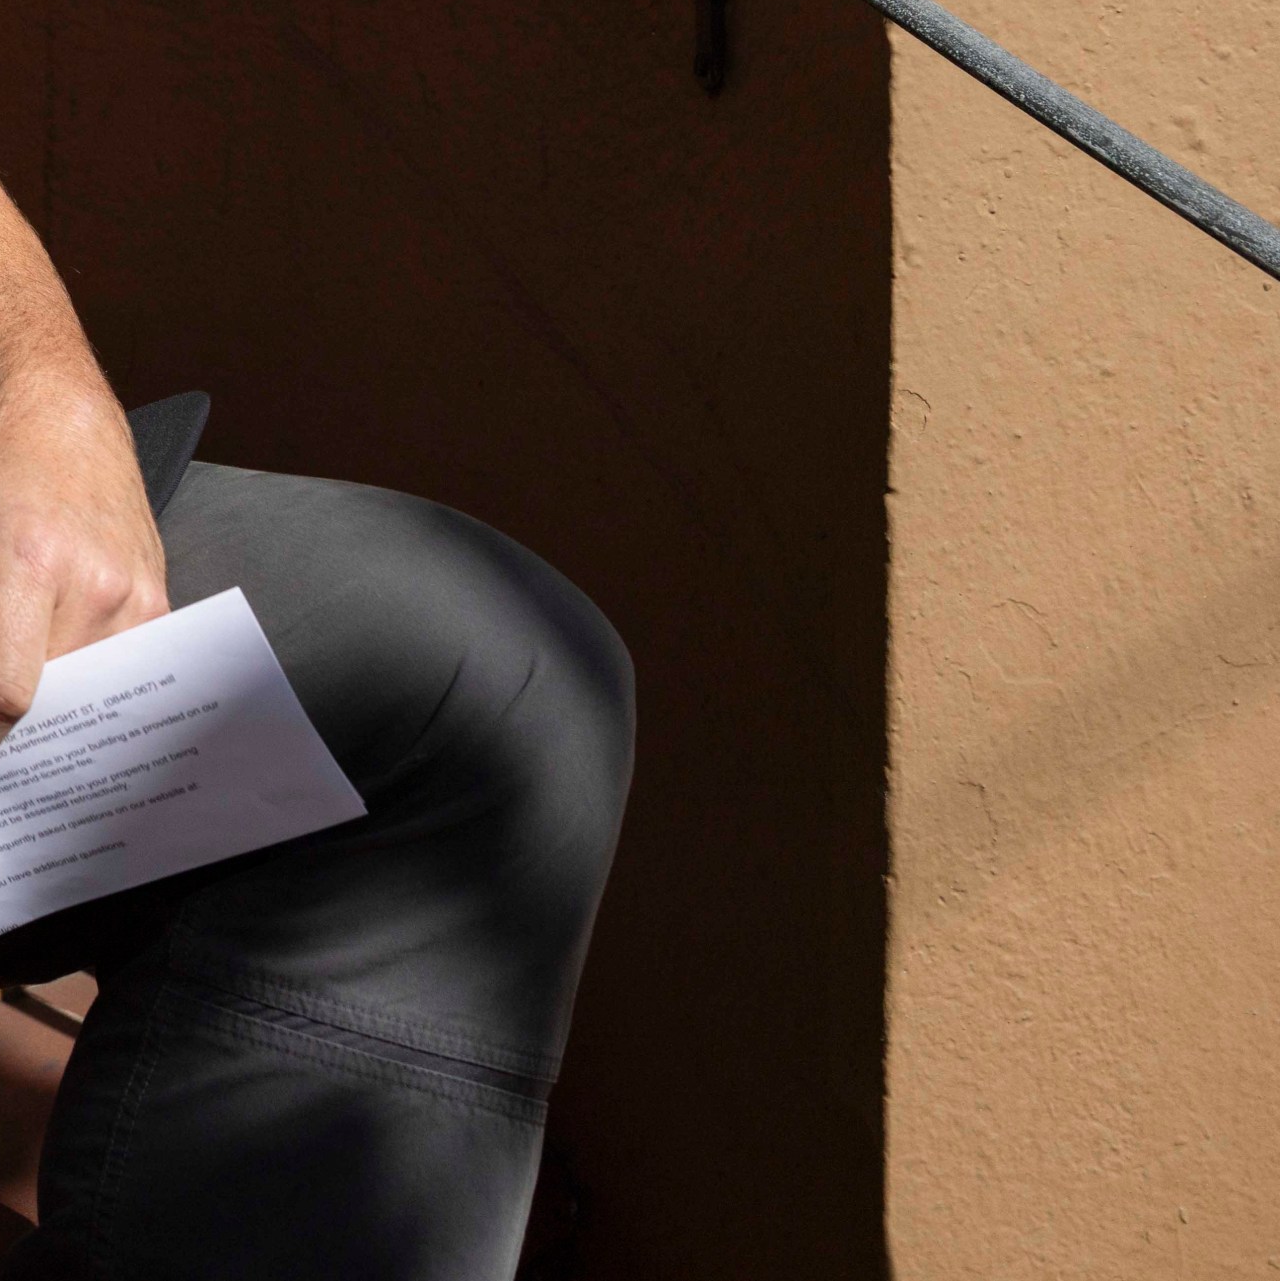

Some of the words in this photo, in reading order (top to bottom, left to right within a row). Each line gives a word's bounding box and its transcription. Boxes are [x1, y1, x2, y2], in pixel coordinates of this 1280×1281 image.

[17, 724, 38, 738] 738
[37, 709, 79, 730] HAIGHT
[158, 673, 176, 687] will
[8, 731, 59, 754] Apartment
[58, 719, 98, 737] License
[29, 759, 53, 772] units
[53, 754, 64, 763] in
[65, 747, 87, 761] your
[87, 732, 128, 752] building
[128, 728, 141, 738] as
[142, 711, 186, 735] provided
[186, 707, 202, 719] on
[202, 701, 220, 713] our
[36, 786, 75, 804] resulted
[74, 783, 86, 792] in
[86, 776, 108, 790] your
[109, 762, 150, 782] property
[151, 755, 168, 768] not
[168, 746, 199, 761] being
[8, 815, 22, 824] be
[24, 800, 69, 819] assessed
[38, 823, 67, 838] asked
[68, 810, 114, 829] questions
[115, 805, 129, 815] on
[129, 800, 146, 811] our
[147, 786, 186, 804] website
[7, 869, 32, 884] have
[32, 853, 78, 875] additional
